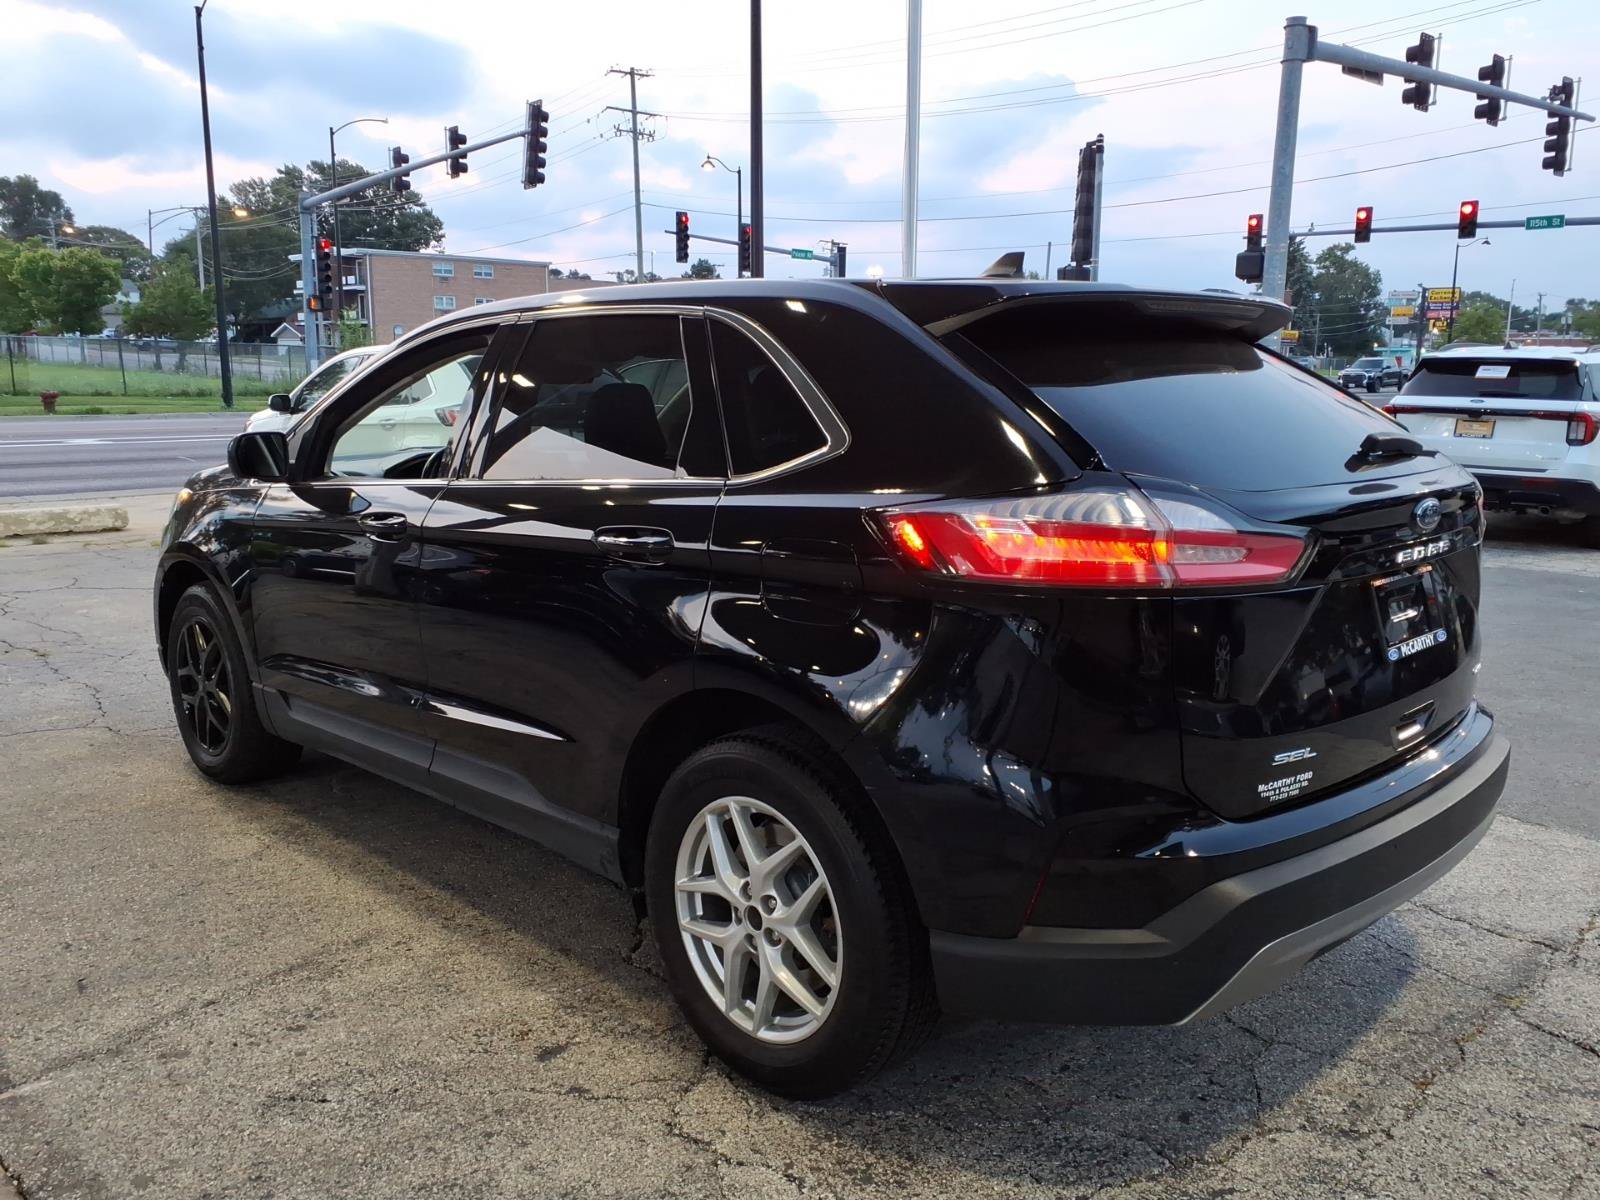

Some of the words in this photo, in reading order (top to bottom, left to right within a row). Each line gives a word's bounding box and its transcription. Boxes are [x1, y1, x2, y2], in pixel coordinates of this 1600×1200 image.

[1530, 219, 1548, 227] 115th
[1552, 218, 1561, 226] St
[1396, 540, 1451, 563] EDGE
[1401, 633, 1435, 658] McCARTHY
[1272, 747, 1317, 766] SEL
[1258, 776, 1296, 793] McCARTHY
[1296, 771, 1313, 783] FORD
